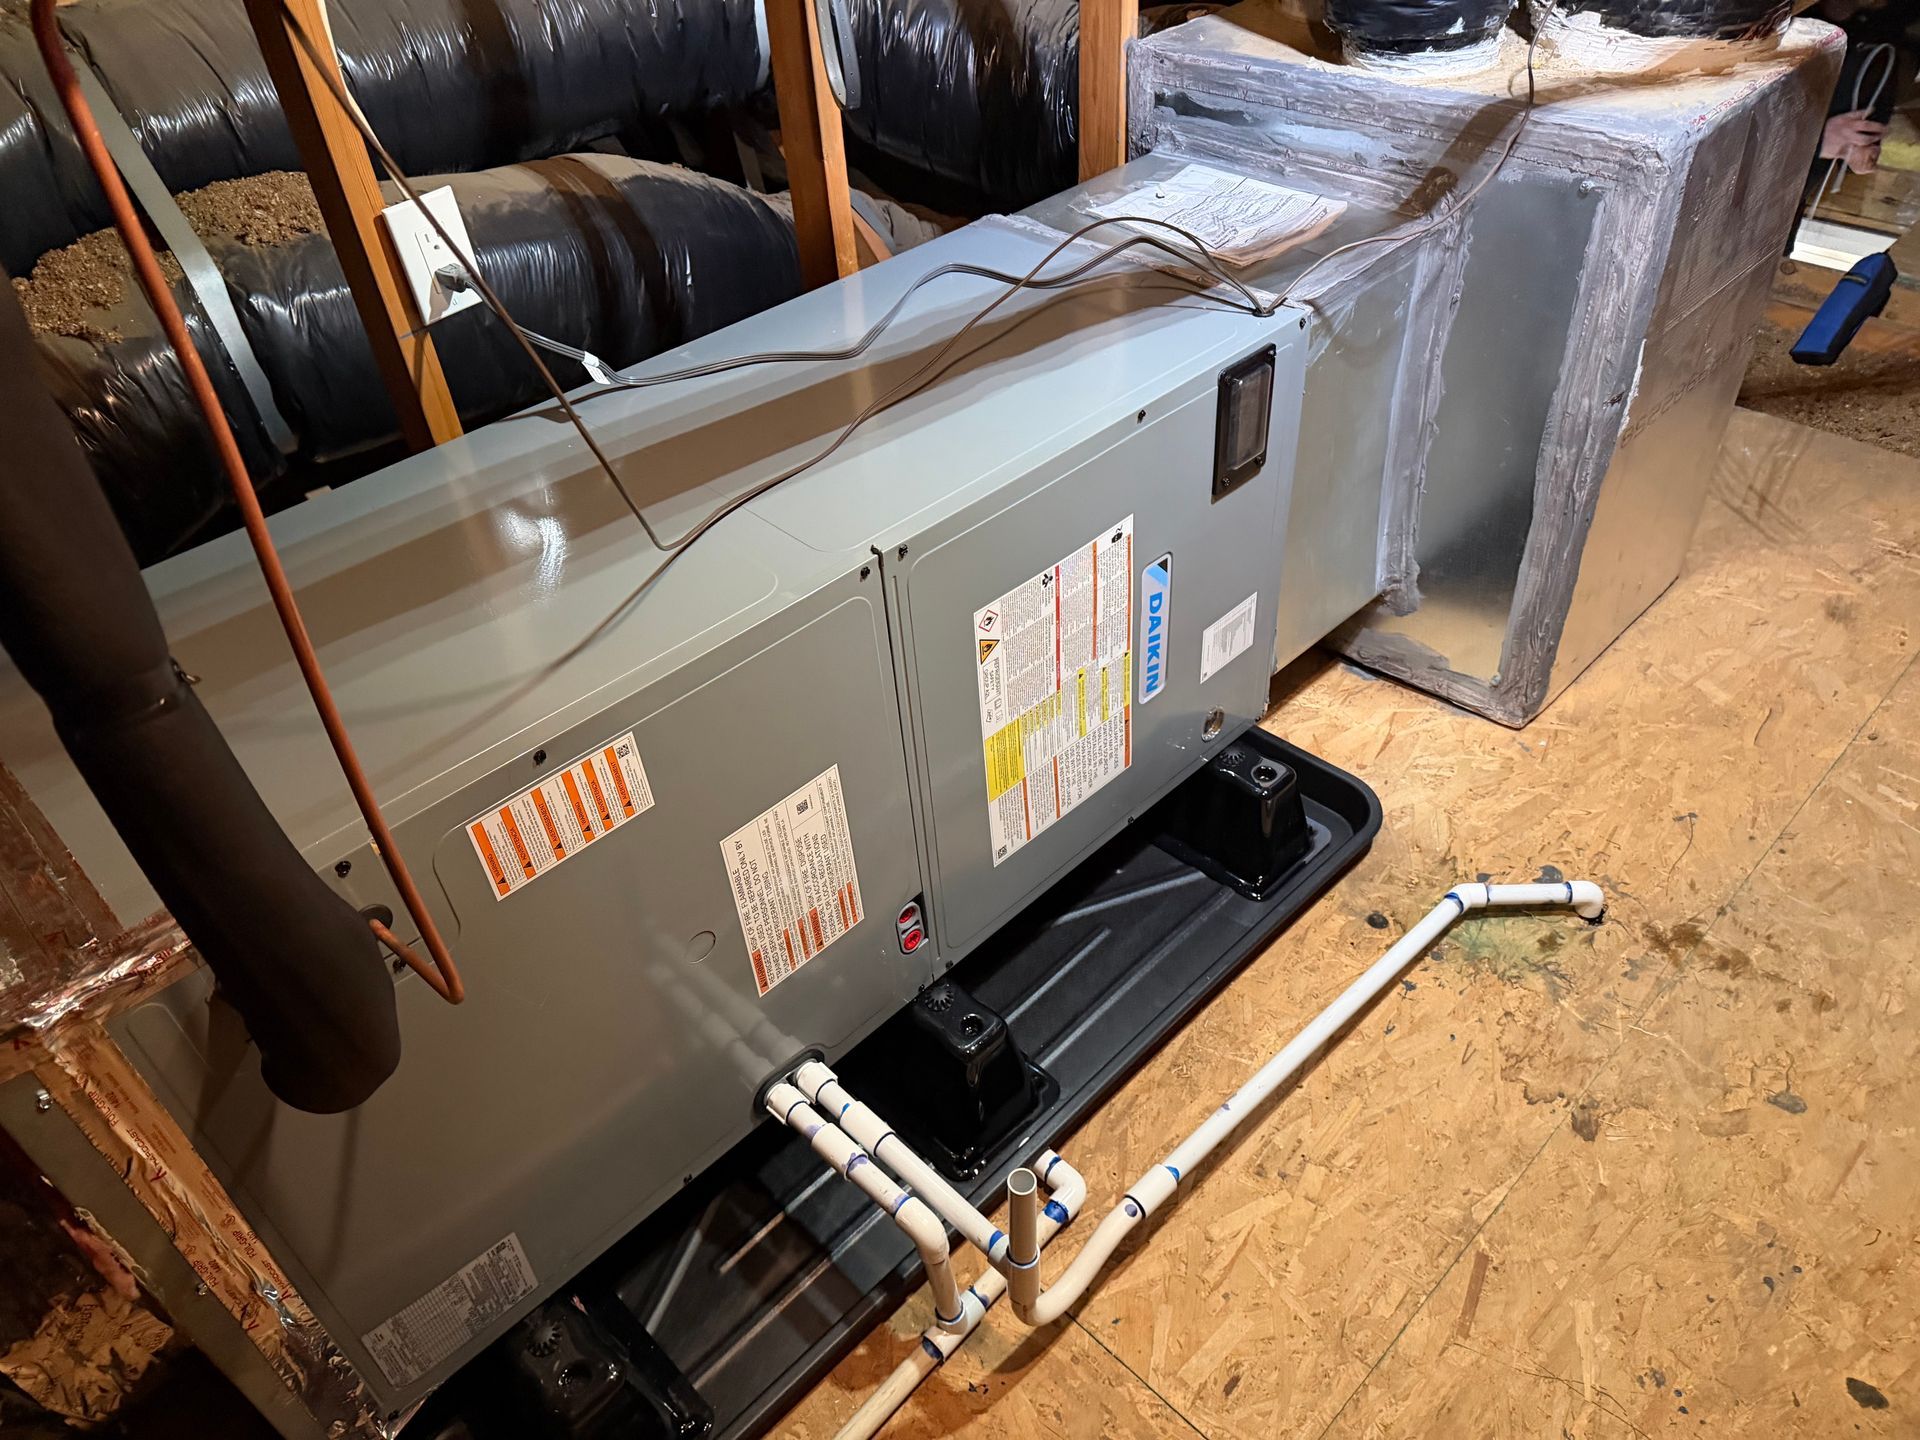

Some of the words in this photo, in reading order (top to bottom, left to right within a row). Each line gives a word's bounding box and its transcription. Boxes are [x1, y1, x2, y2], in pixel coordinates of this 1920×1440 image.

[1146, 592, 1162, 693] DAIKIN
[610, 760, 627, 800] AVERTISSEMENT
[590, 778, 606, 813] ADVERTENCIA
[538, 801, 557, 843] AVERTISSEMENT
[574, 800, 586, 825] WARNING
[508, 826, 527, 861] ADVERTENCIA
[734, 838, 742, 851] BY
[795, 836, 806, 867] DISPOSE
[803, 832, 811, 852] WITH
[486, 852, 501, 878] WARNING
[737, 849, 747, 870] ONLY
[749, 857, 758, 875] NOT
[806, 850, 820, 896] ACCORDANCE
[824, 851, 837, 897] REFRIGERANT
[732, 867, 747, 909] FLAMMABLE
[742, 868, 755, 903] REPAIRED
[752, 872, 760, 886] DO
[804, 882, 811, 894] OF
[820, 878, 829, 901] LOCAL
[750, 902, 758, 914] BE
[806, 892, 814, 909] RISK
[815, 894, 822, 903] IN
[825, 898, 831, 911] OR
[746, 923, 754, 936] OF
[752, 911, 760, 923] TO
[767, 895, 782, 941] REFRIGERANT
[810, 912, 821, 942] WARNING
[827, 909, 837, 937] FEDERAL
[749, 934, 758, 951] RISK
[765, 925, 777, 953] SERVICE
[753, 953, 766, 983] WARNING
[760, 941, 775, 984] REFRIGERANT
[771, 951, 783, 979] TRAINED
[778, 939, 790, 973] PUNCTURE
[87, 1087, 120, 1127] FOIL-GRIP
[104, 1089, 122, 1109] 1402
[127, 1125, 159, 1167] HARDCAST
[232, 1228, 257, 1259] FOIL-GRIP
[193, 1256, 219, 1288] FOIL-GRIP
[261, 1257, 286, 1290] HARDCAST
